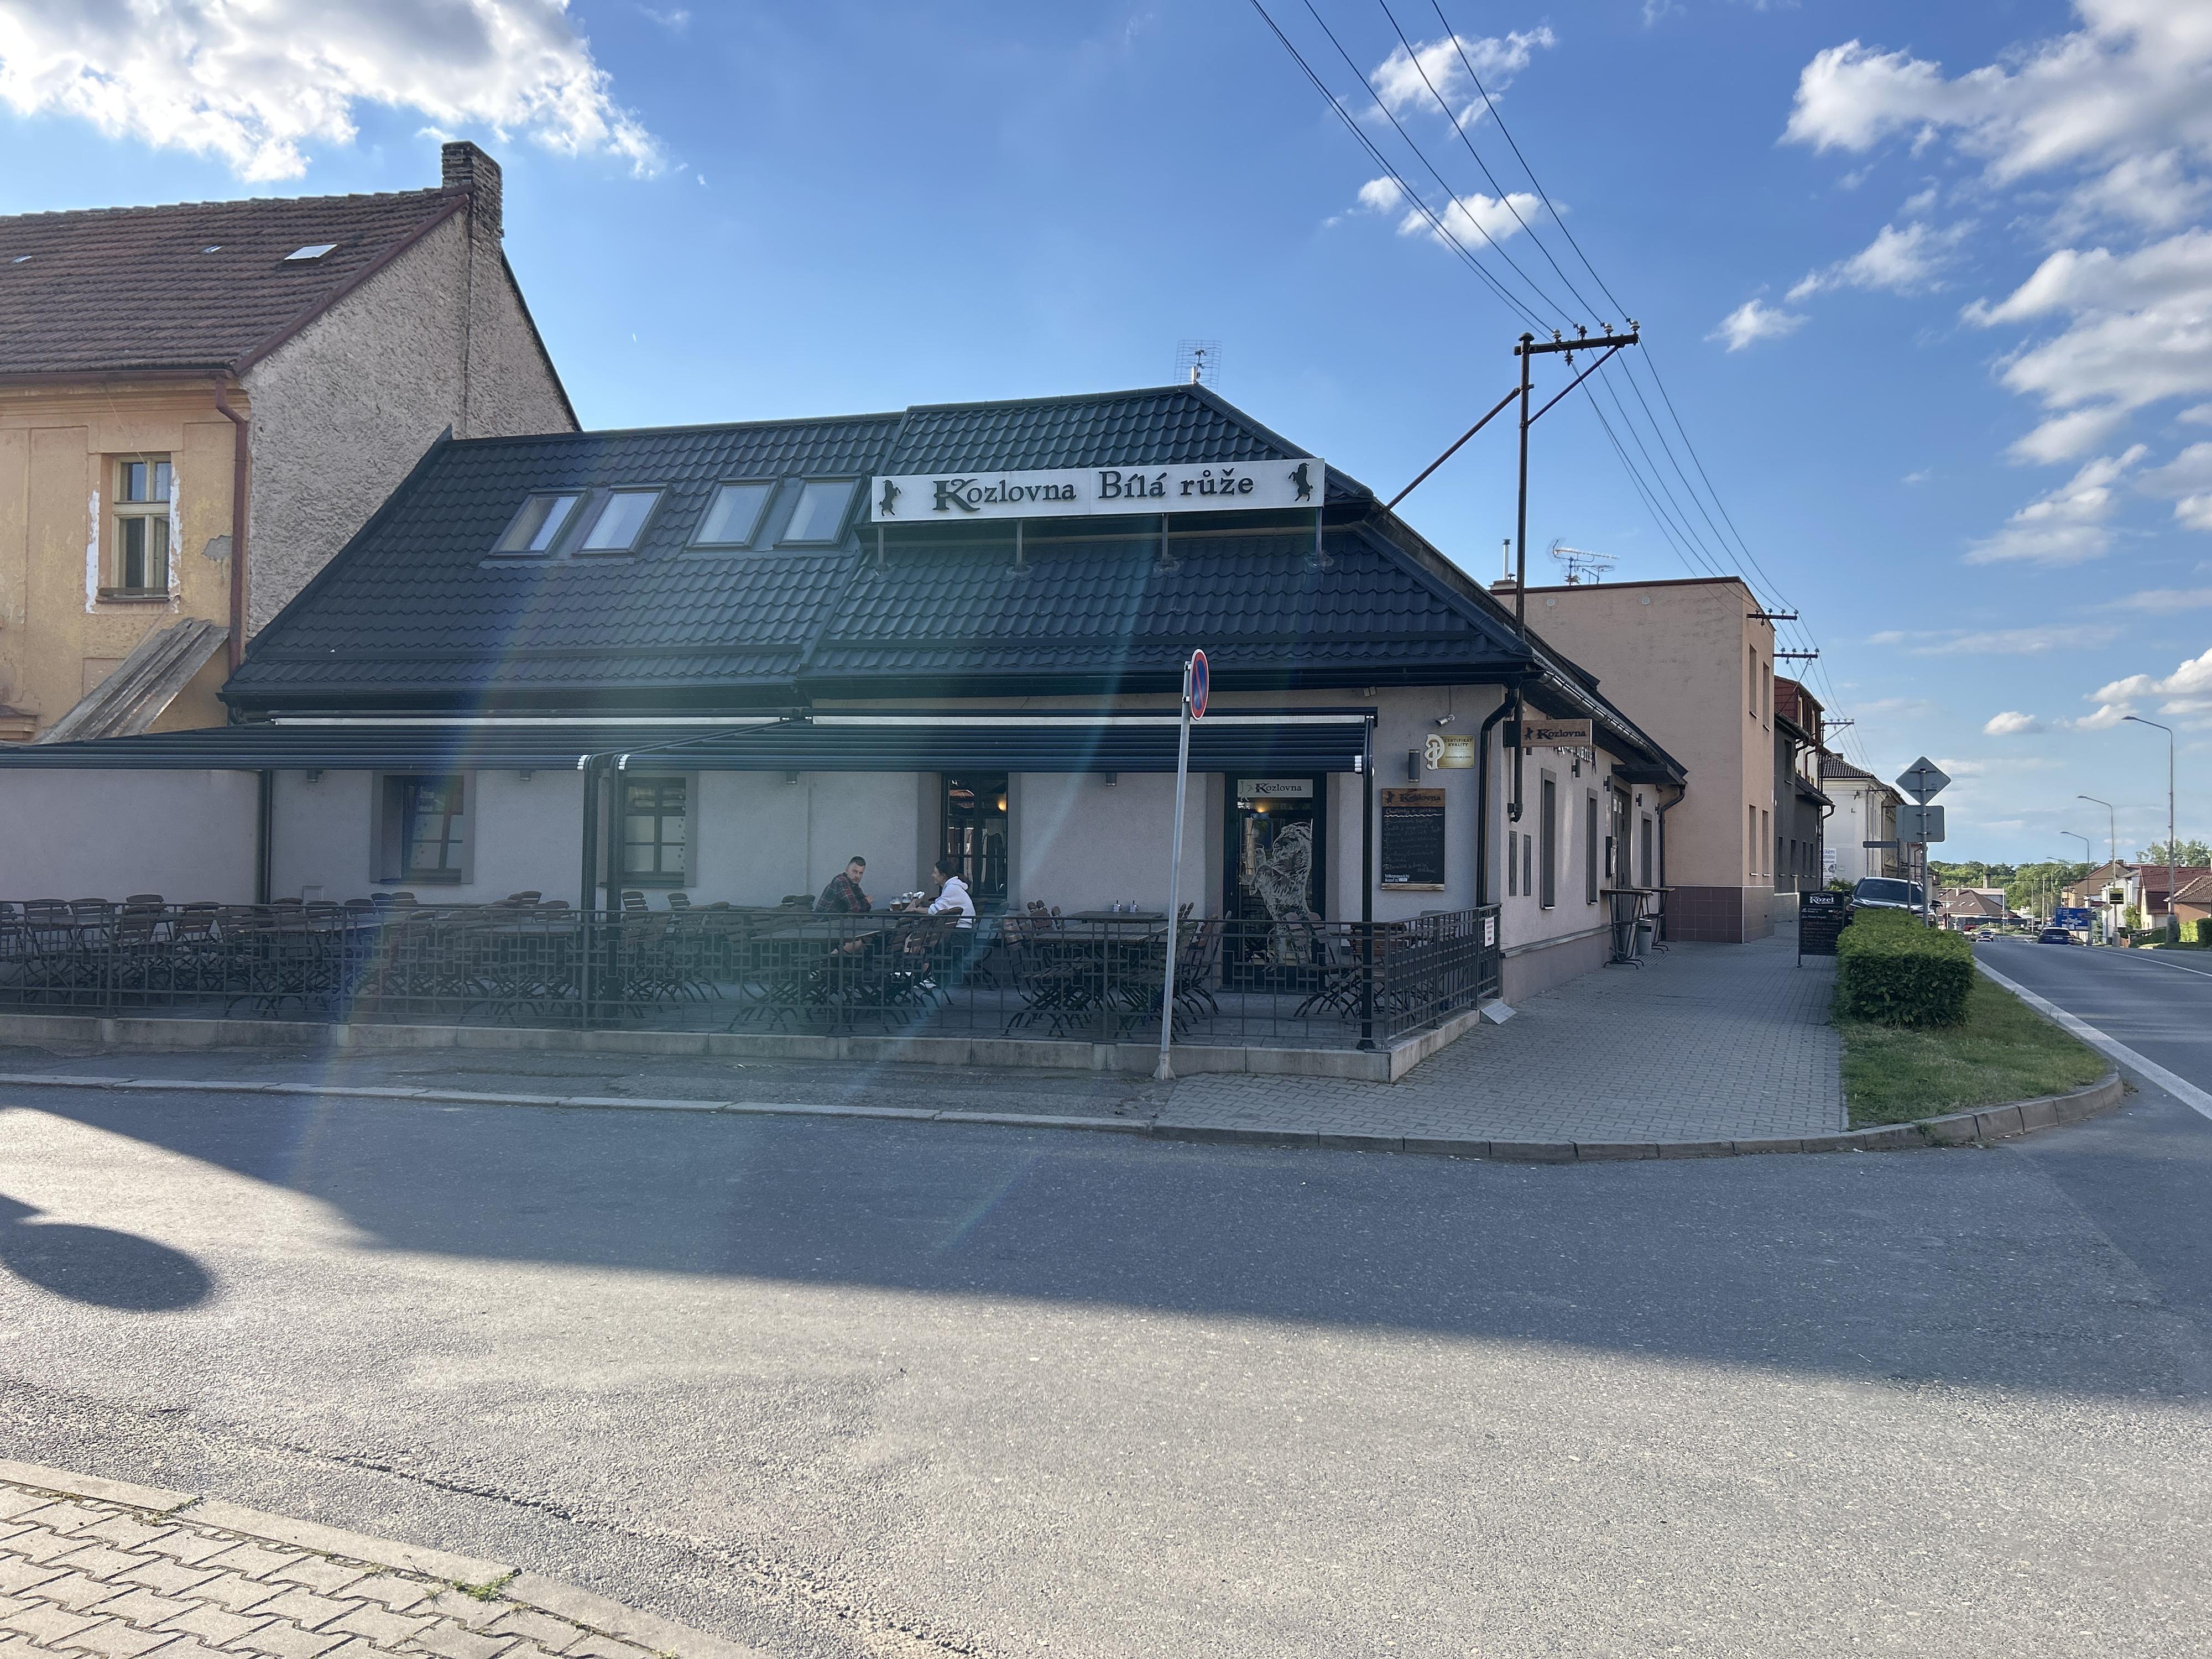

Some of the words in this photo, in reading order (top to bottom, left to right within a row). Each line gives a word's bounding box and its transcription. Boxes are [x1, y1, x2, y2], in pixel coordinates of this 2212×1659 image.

[933, 479, 1076, 512] Kozlovna
[1098, 471, 1167, 499] Bílá
[1180, 468, 1254, 495] růže
[1537, 728, 1586, 739] Kozlovna
[1255, 782, 1302, 794] Kozlovna
[1809, 896, 1834, 904] Kozel
